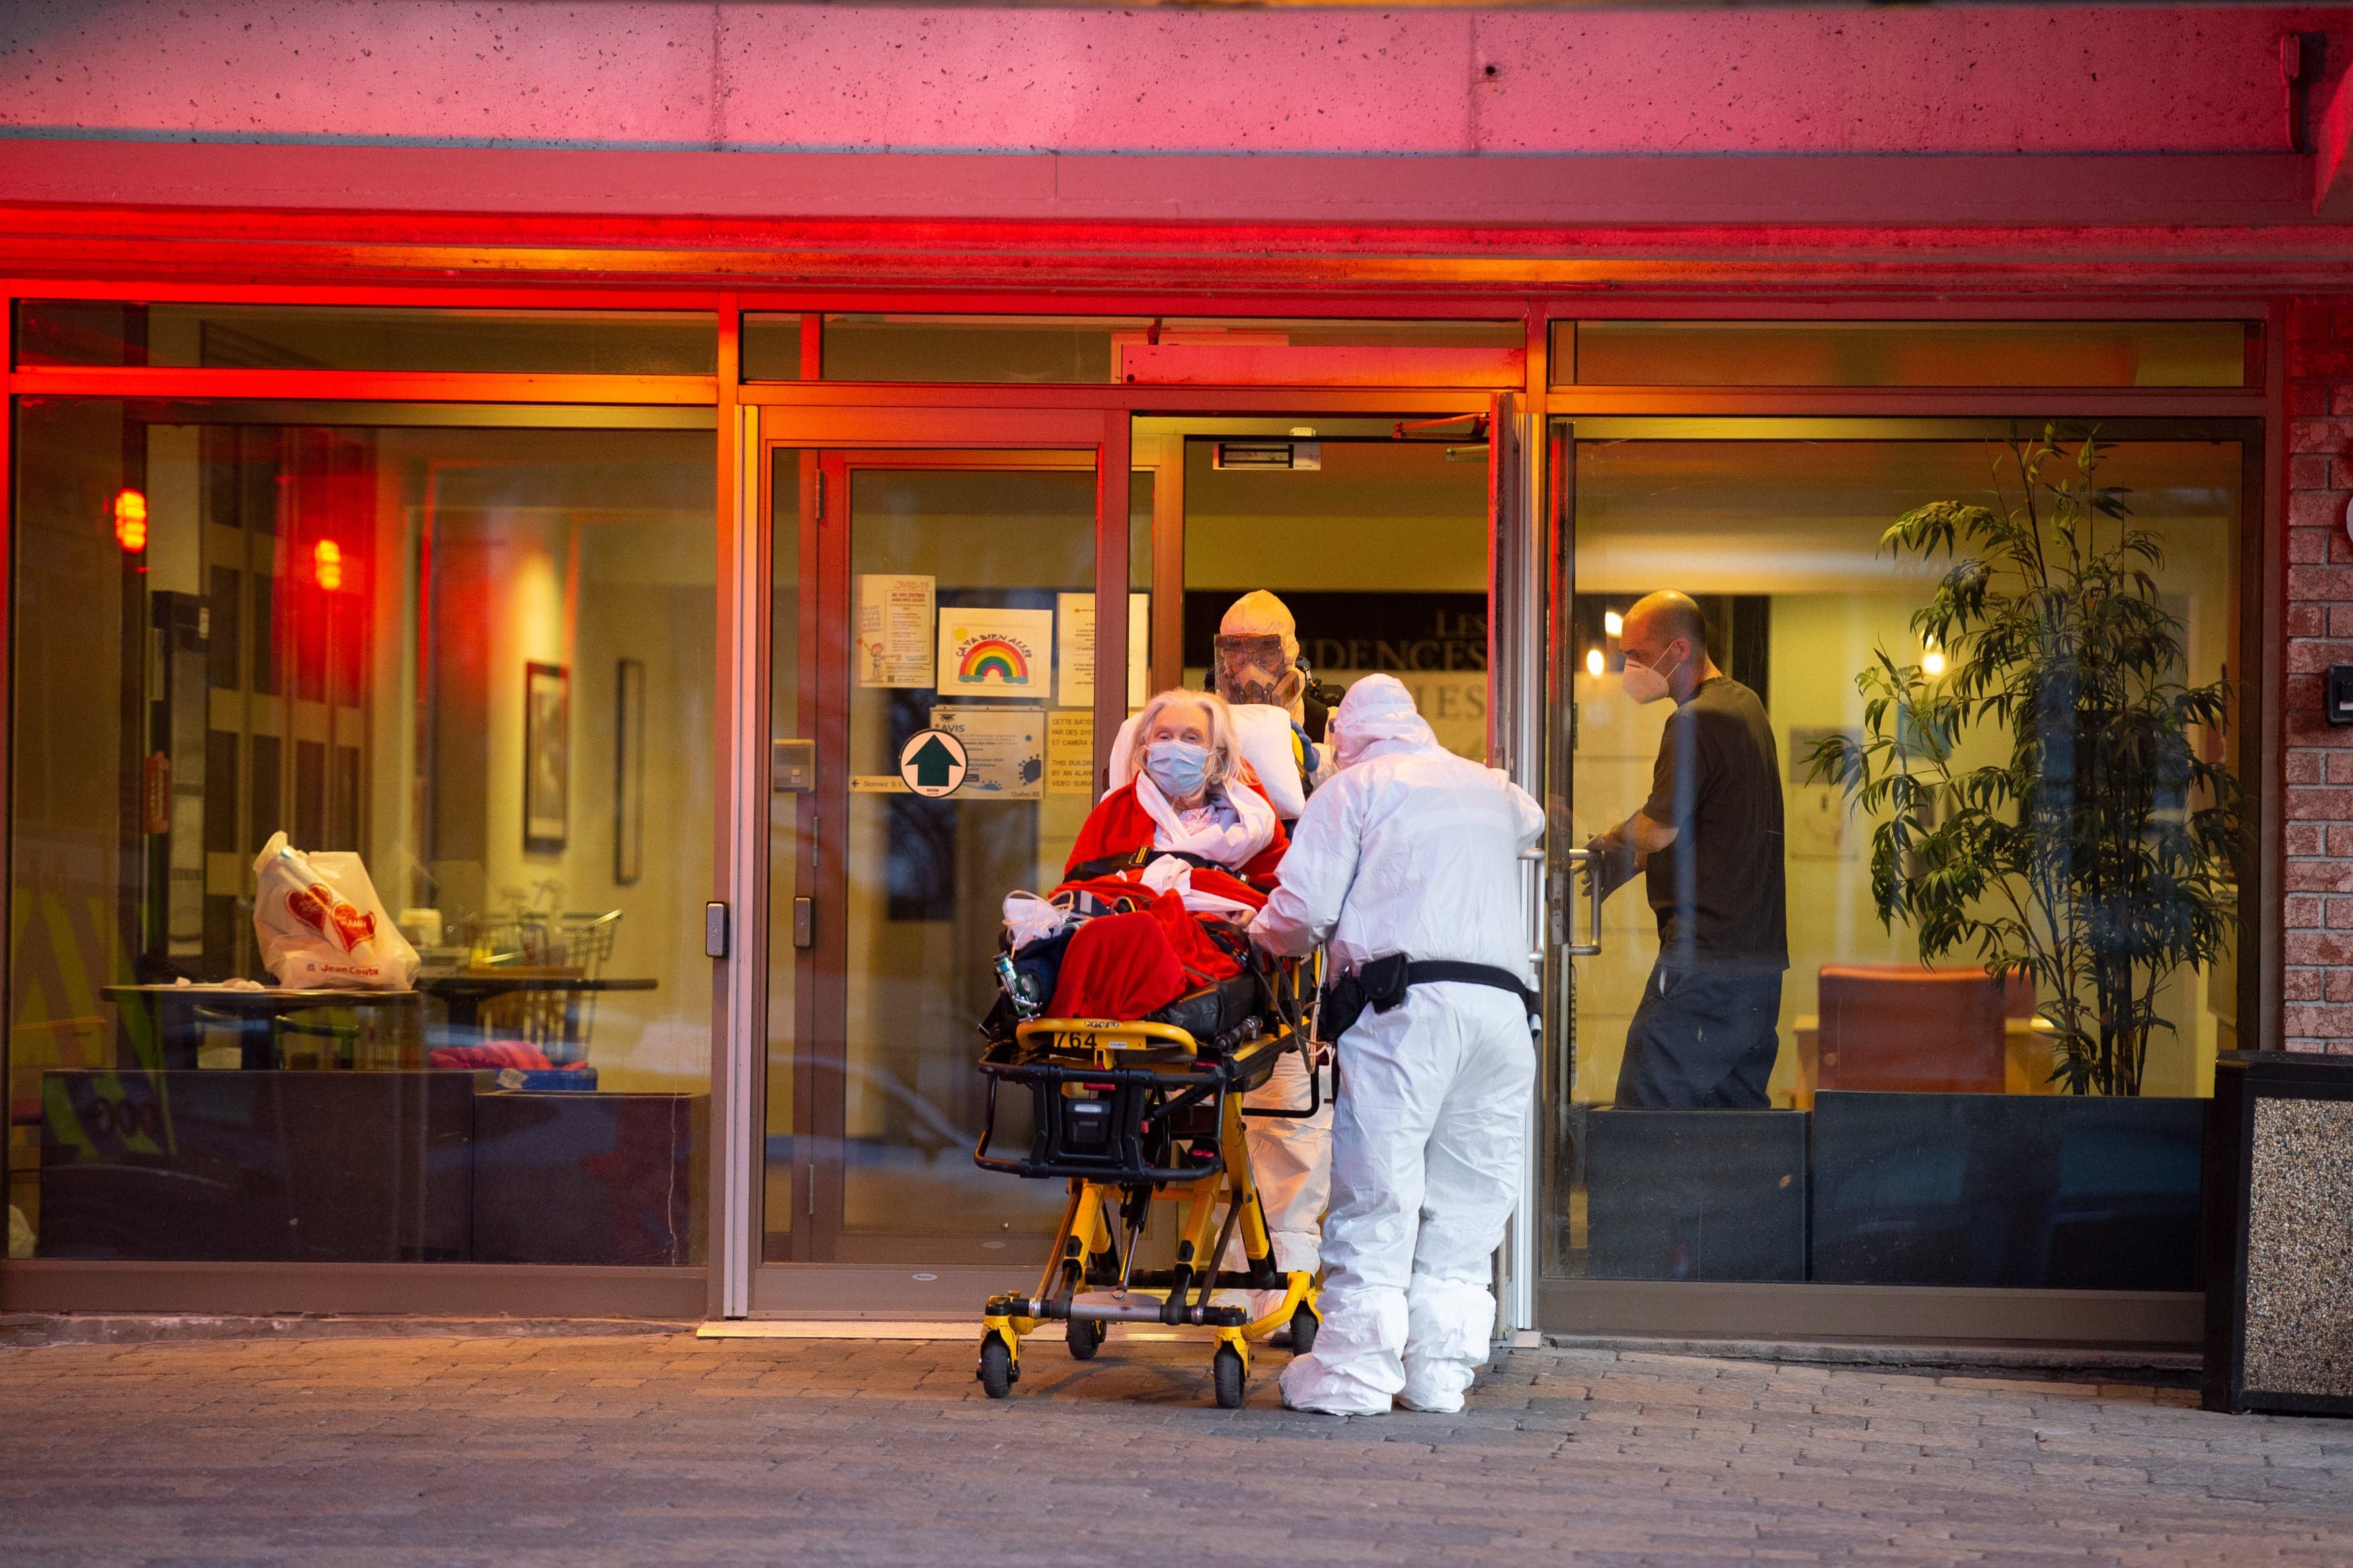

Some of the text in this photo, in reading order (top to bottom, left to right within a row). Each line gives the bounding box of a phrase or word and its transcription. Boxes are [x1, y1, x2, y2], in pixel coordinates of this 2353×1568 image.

[963, 636, 979, 645] VA
[1008, 637, 1032, 658] ALLER
[941, 724, 965, 733] AVIS
[321, 964, 348, 973] Jean
[1055, 1032, 1097, 1048] 764
